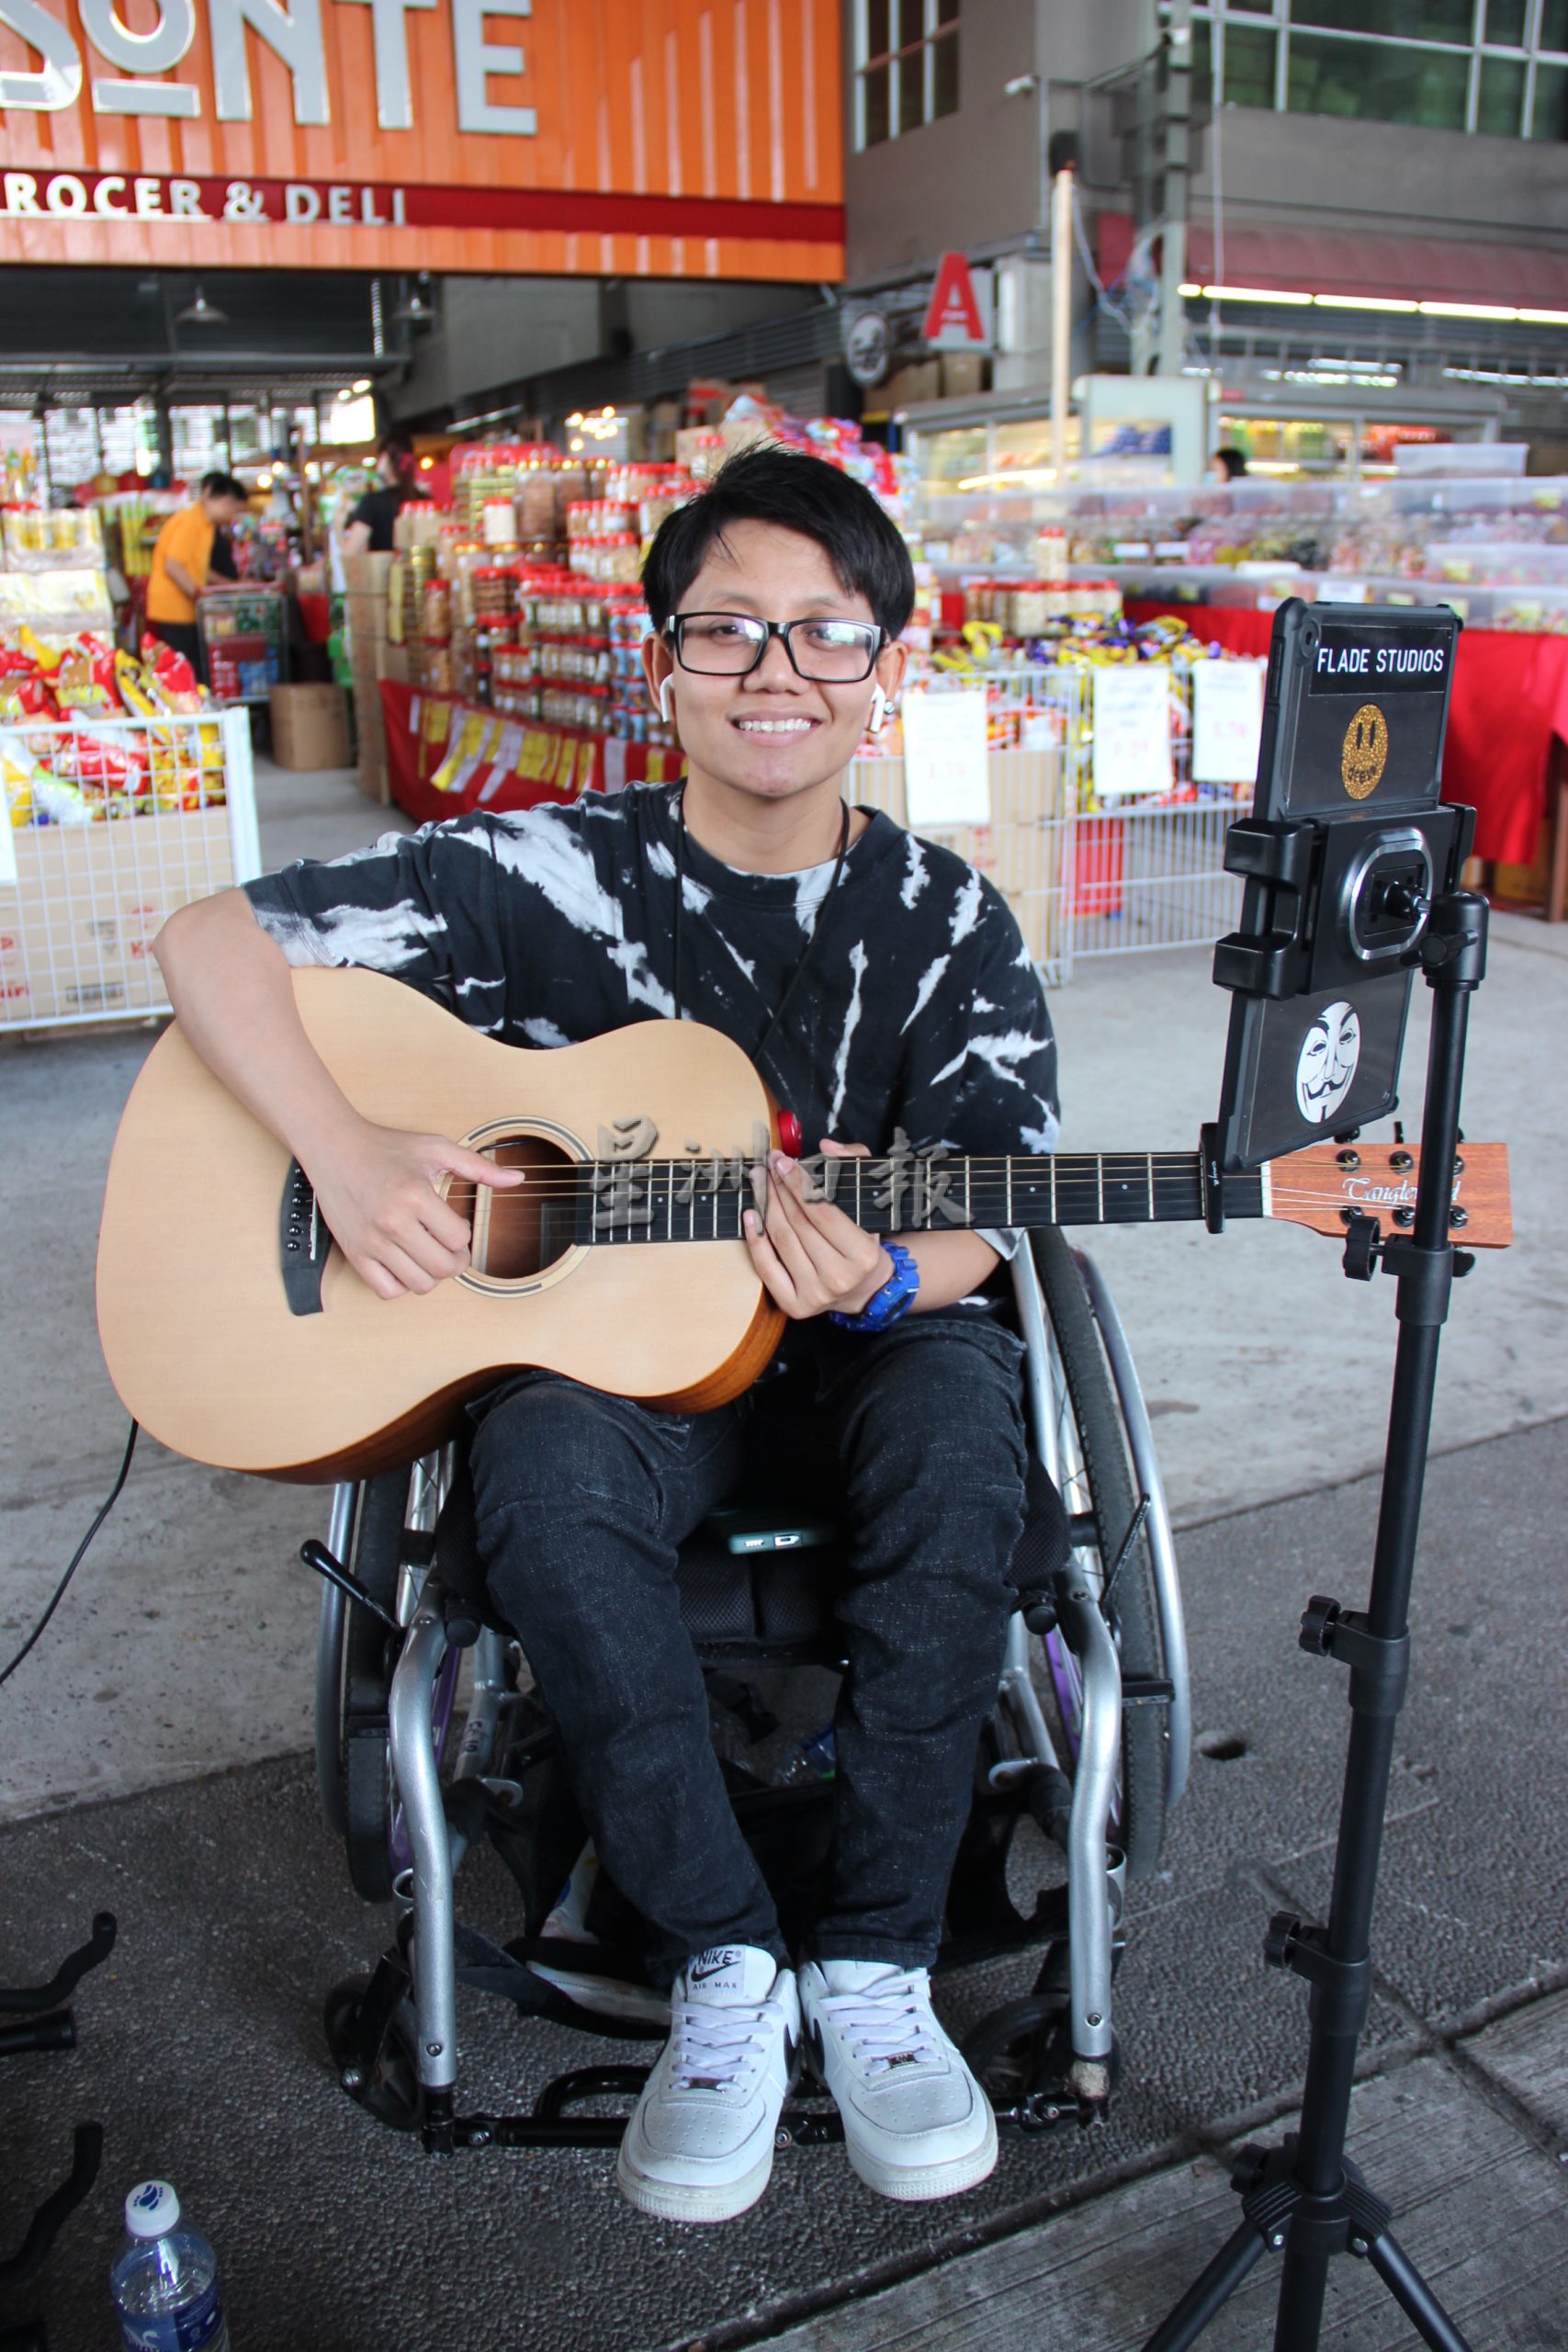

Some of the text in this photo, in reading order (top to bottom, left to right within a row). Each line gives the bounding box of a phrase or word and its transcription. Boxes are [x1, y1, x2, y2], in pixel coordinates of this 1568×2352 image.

[4, 172, 407, 226] ROCER & DELI
[922, 251, 986, 340] A
[1316, 648, 1444, 673] FLADE STUDIOS
[693, 1982, 706, 1991] AIR
